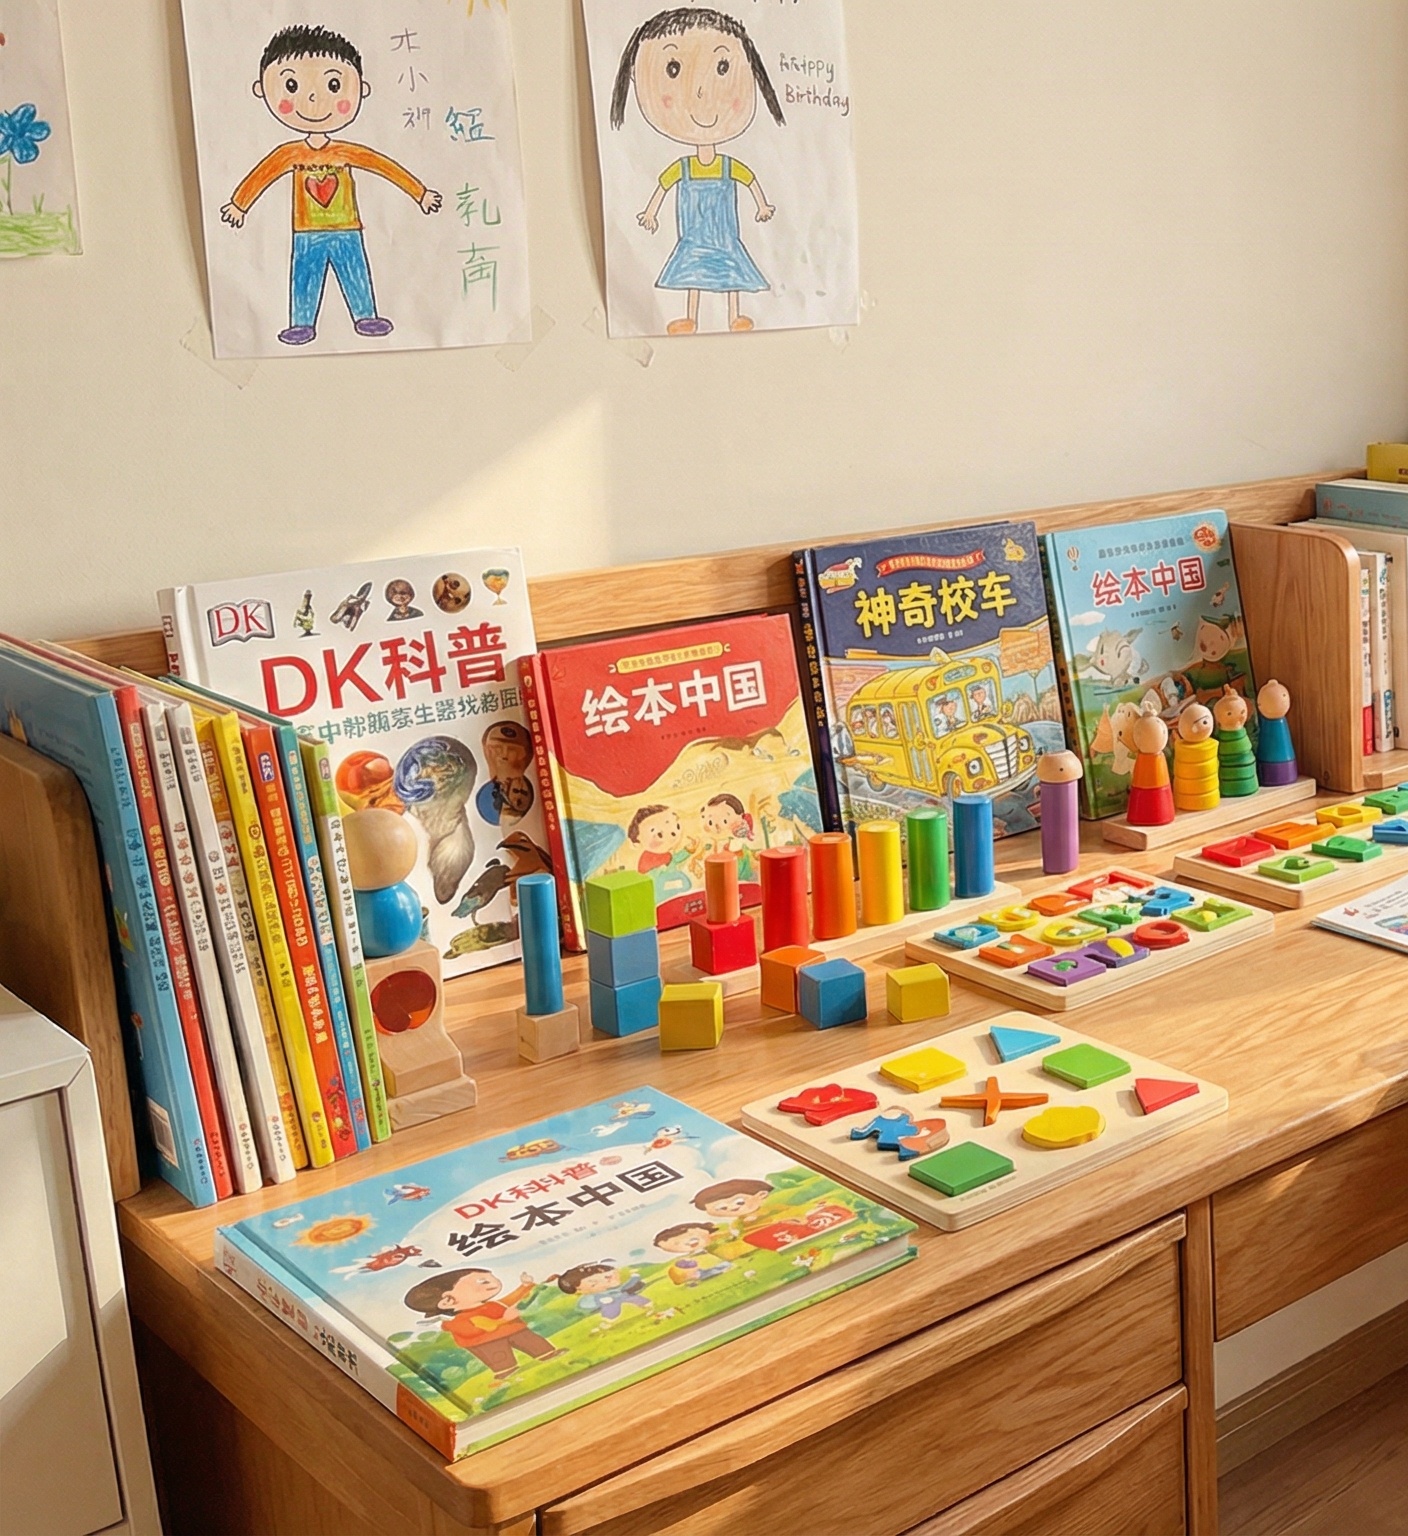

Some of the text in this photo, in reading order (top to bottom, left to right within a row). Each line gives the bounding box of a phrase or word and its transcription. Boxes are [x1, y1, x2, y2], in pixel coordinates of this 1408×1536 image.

[854, 571, 1017, 638] 神奇校车
[1092, 556, 1206, 607] 绘本中国
[213, 602, 268, 638] DK
[260, 622, 507, 717] DK科普
[581, 660, 768, 738] 绘本中国
[447, 1160, 684, 1257] 绘本中国
